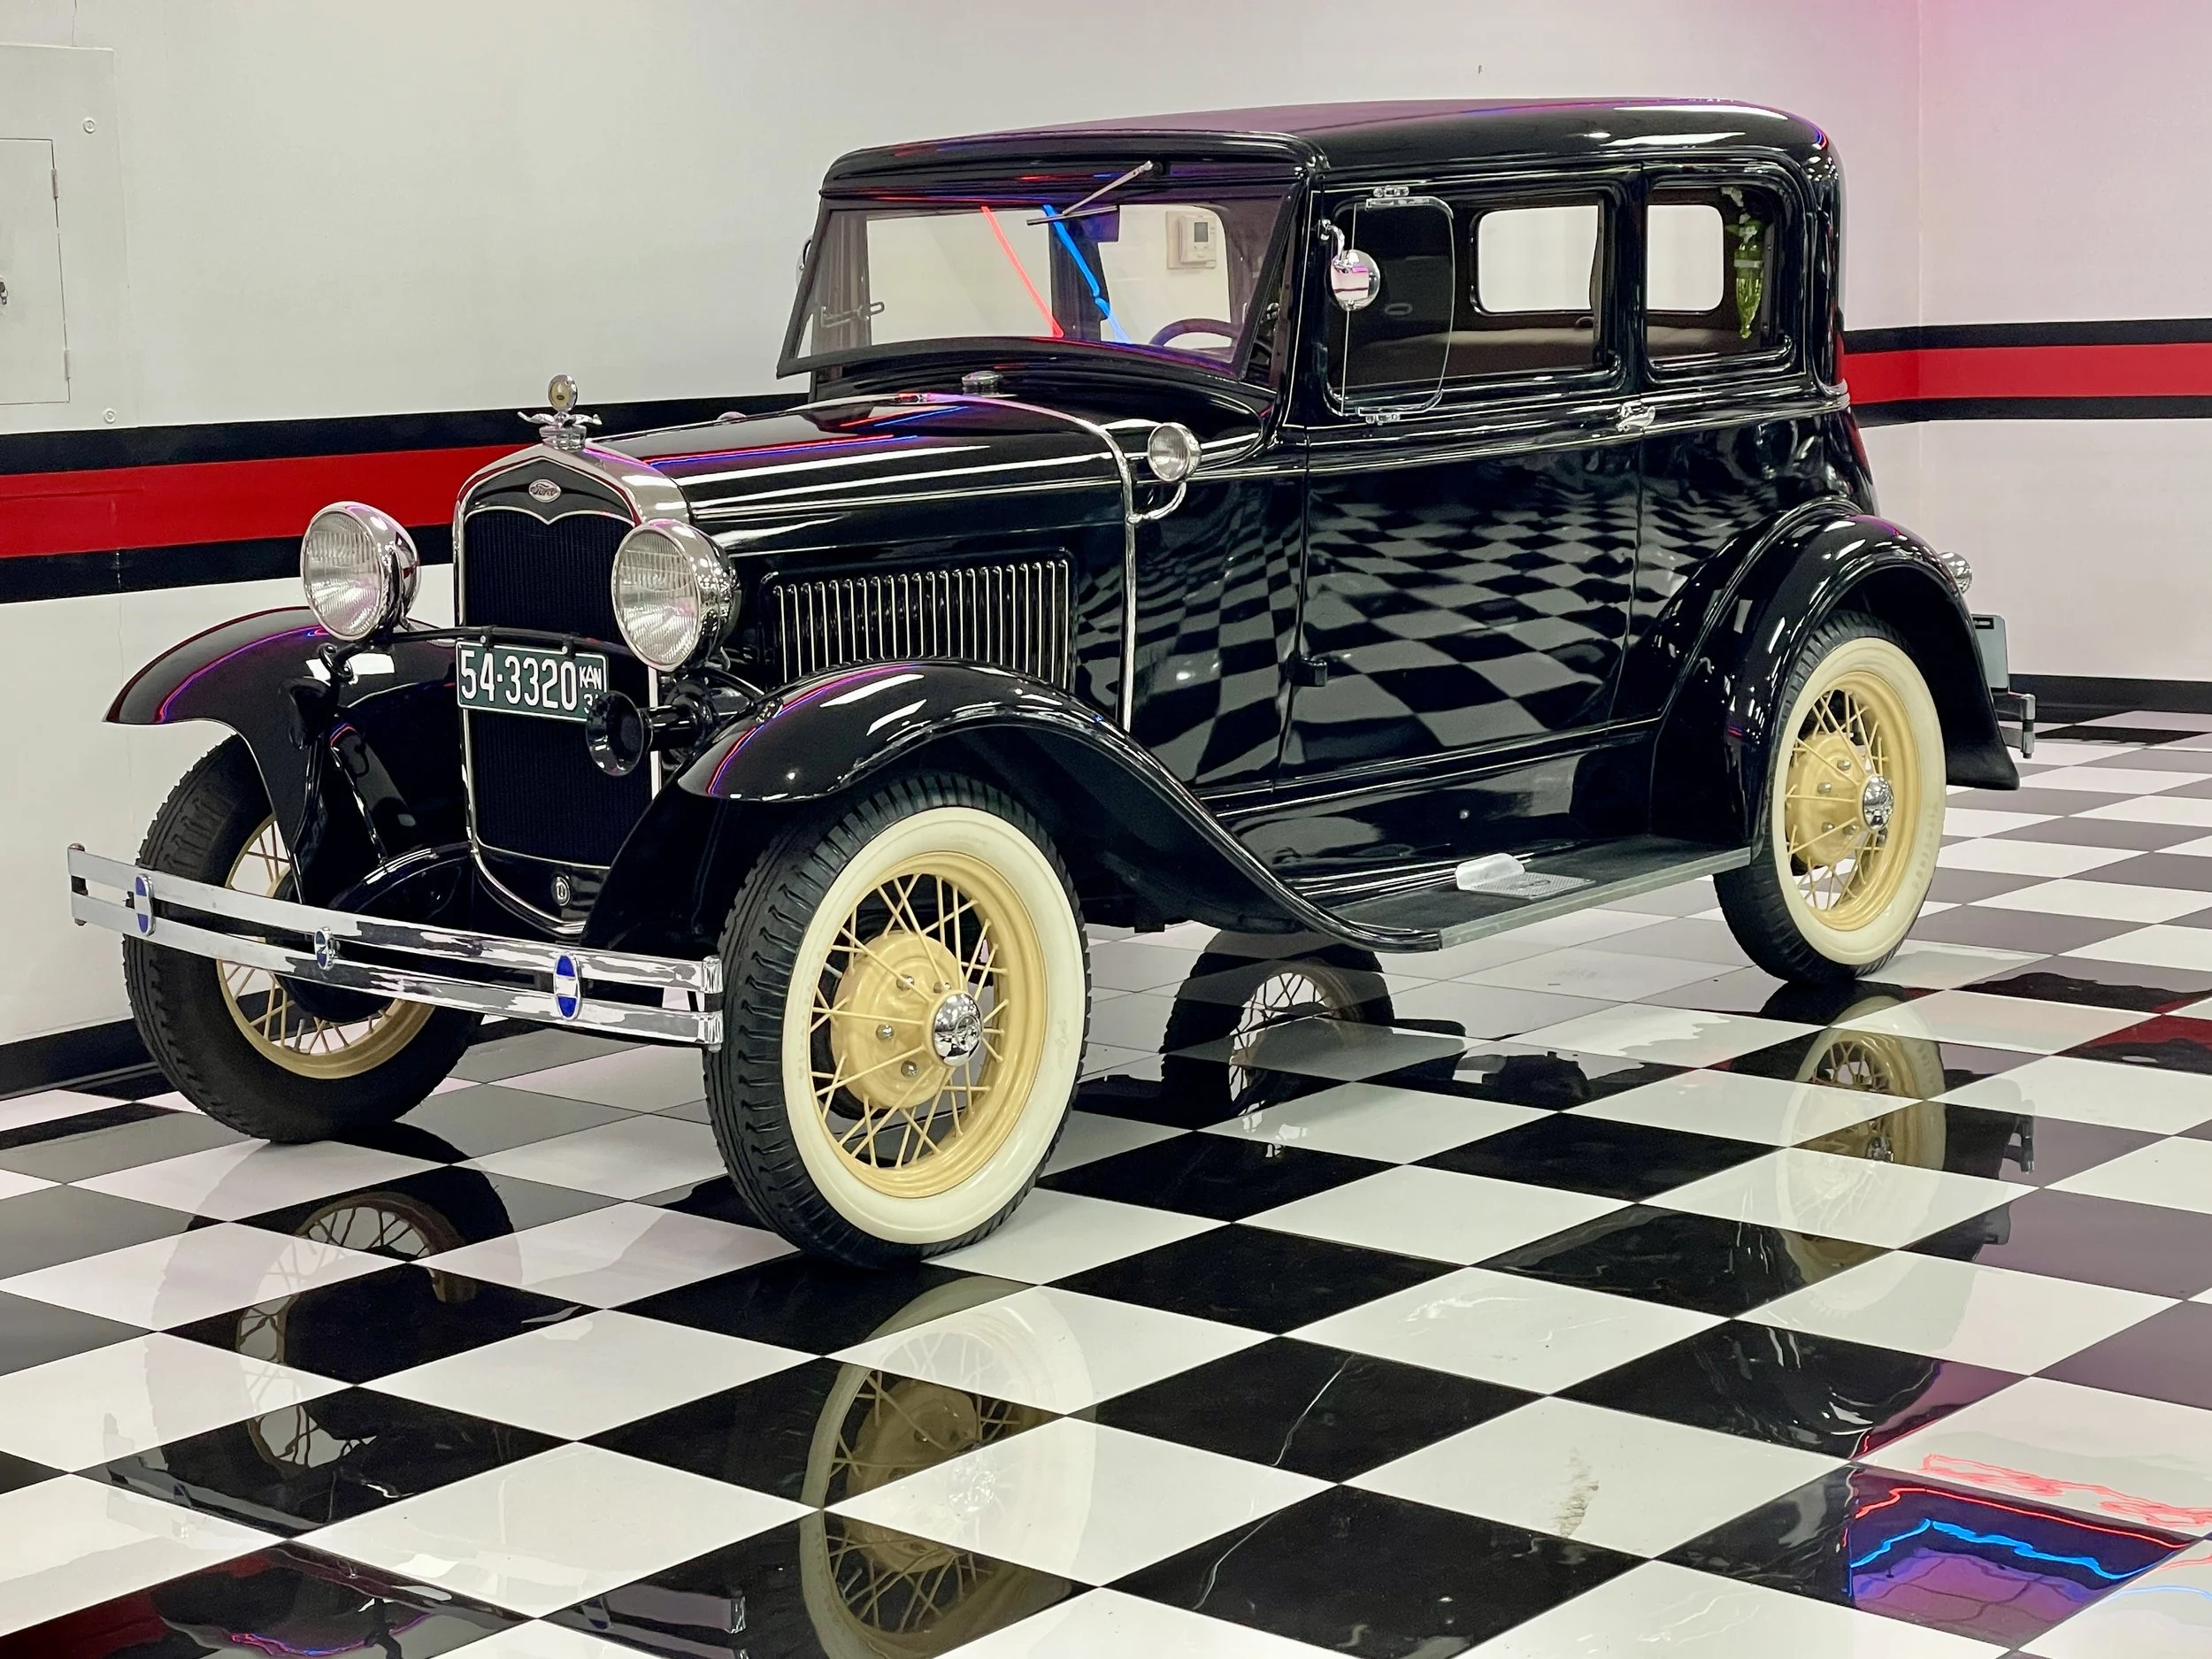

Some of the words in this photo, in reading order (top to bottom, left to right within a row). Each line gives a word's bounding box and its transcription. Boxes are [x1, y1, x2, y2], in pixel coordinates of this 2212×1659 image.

[531, 483, 557, 496] Ford
[579, 664, 602, 690] KAN
[583, 693, 599, 714] 3
